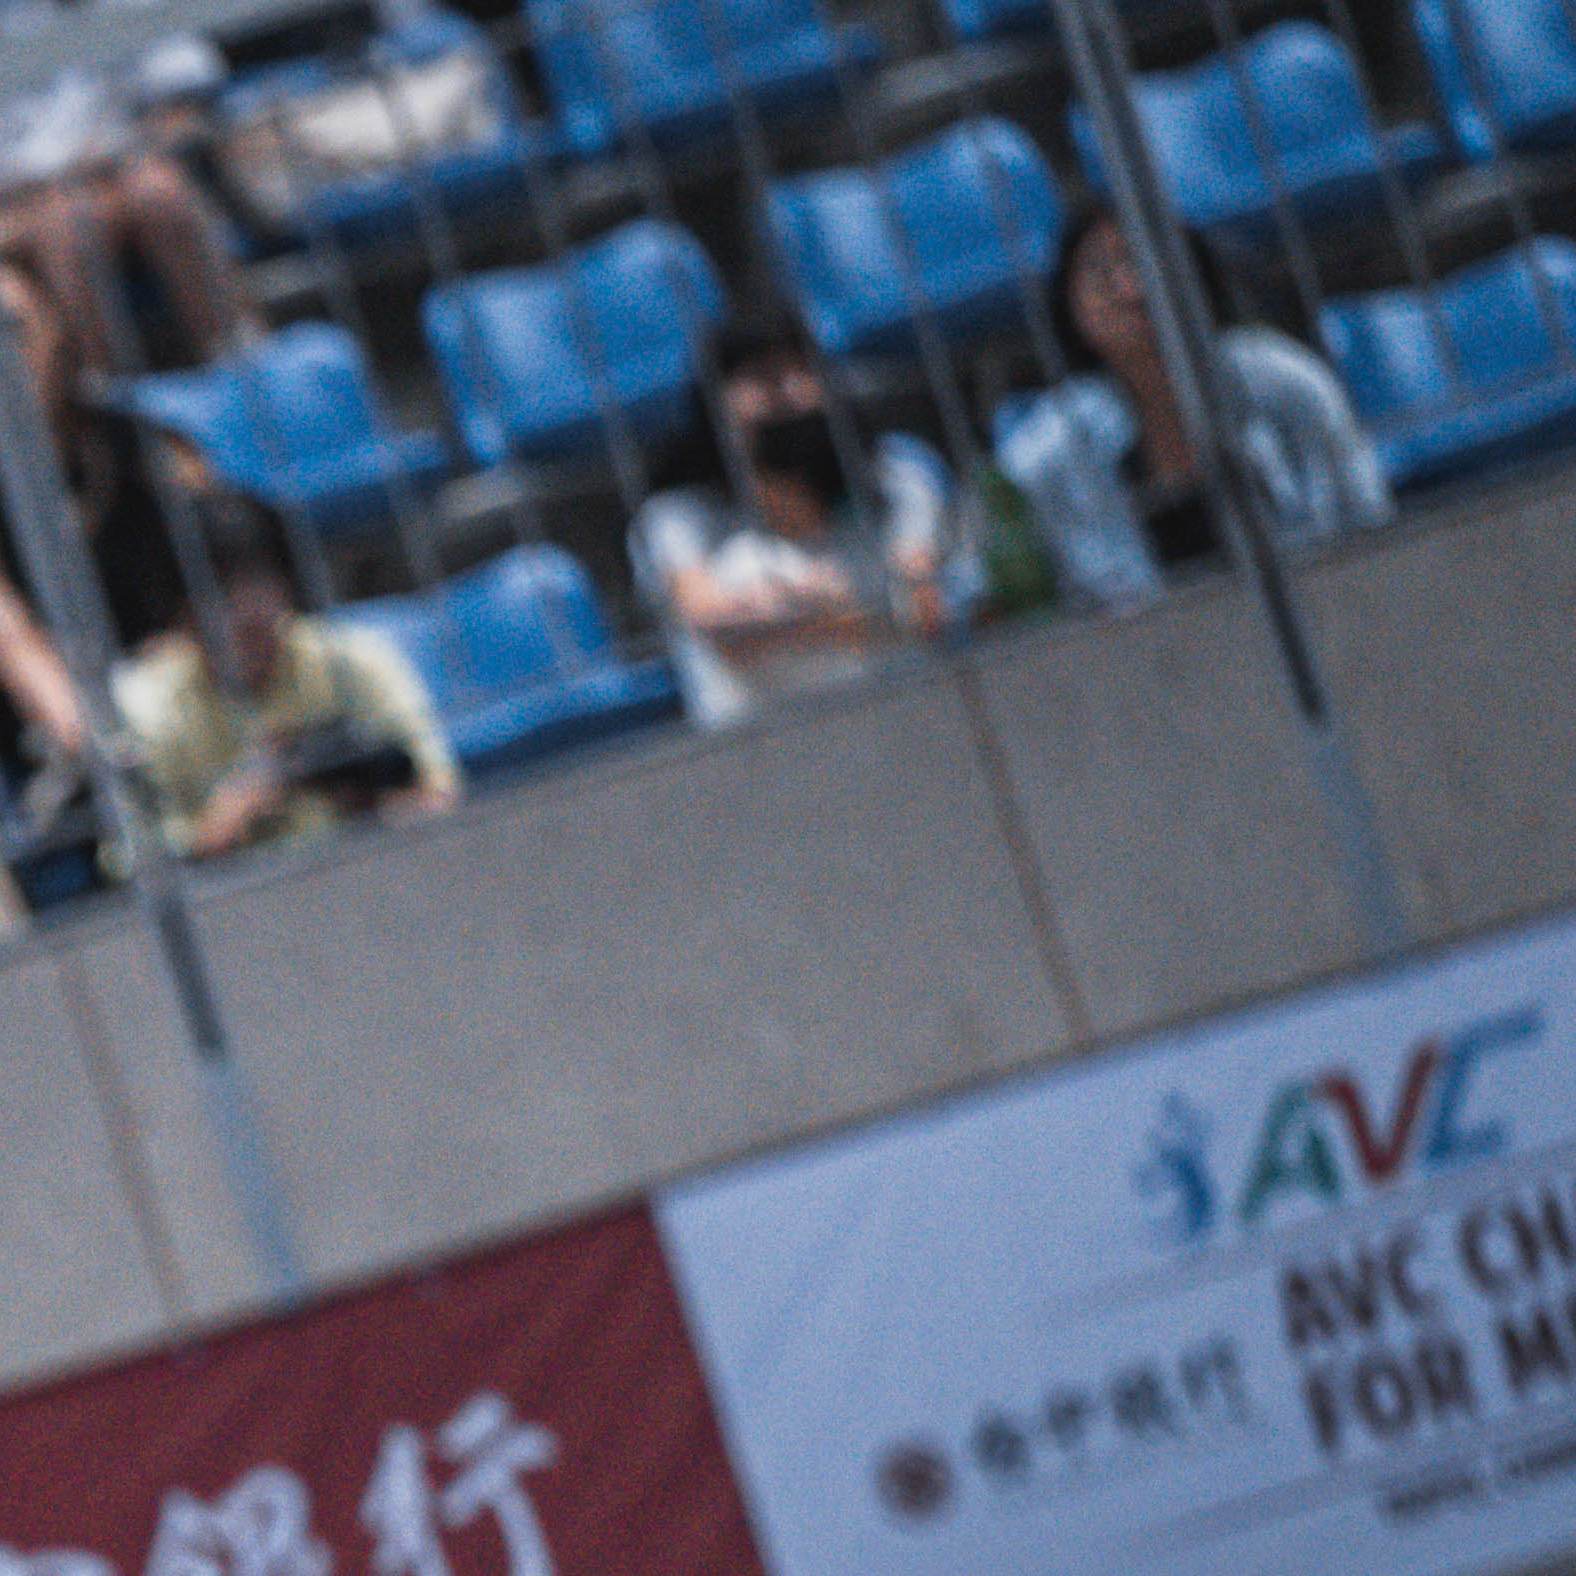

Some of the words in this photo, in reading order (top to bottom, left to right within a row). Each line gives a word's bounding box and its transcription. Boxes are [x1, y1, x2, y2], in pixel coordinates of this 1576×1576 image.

[1234, 1005, 1544, 1228] AVC
[1279, 1228, 1441, 1352] AVC
[1301, 1335, 1477, 1458] FOR
